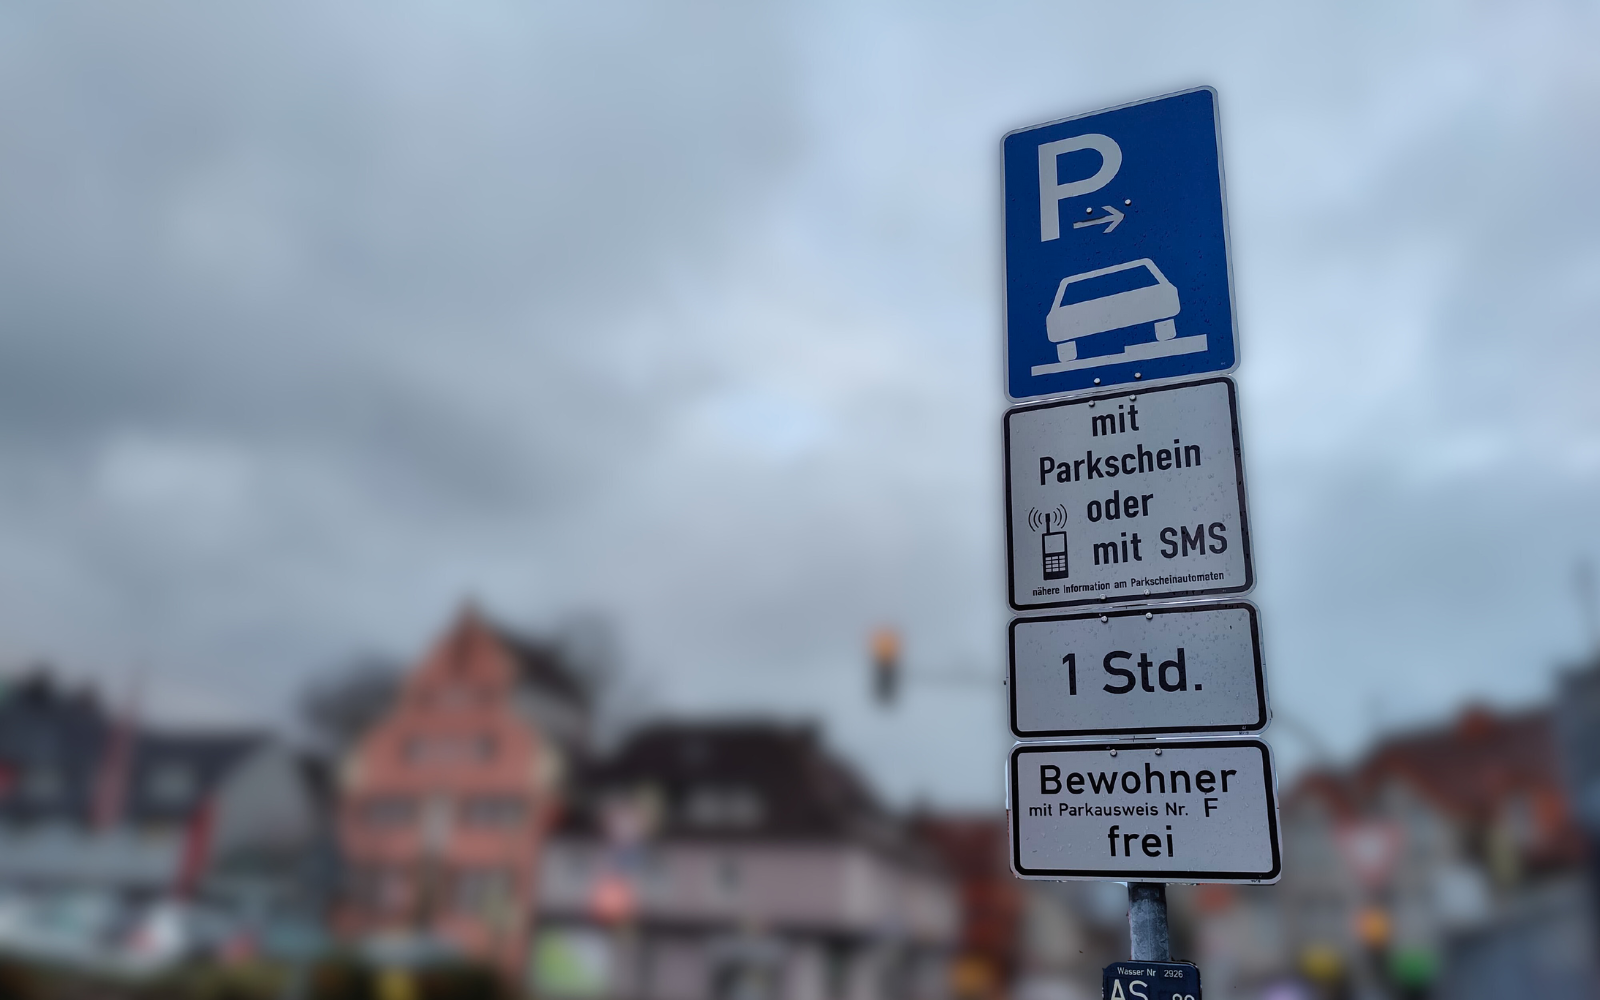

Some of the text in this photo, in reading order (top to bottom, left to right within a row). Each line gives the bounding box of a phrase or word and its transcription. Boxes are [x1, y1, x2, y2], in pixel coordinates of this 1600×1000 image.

[1038, 133, 1123, 242] P
[1091, 404, 1139, 436] mit
[1039, 438, 1202, 485] Parkschein
[1087, 489, 1154, 523] oder
[1093, 522, 1228, 565] mit SMS
[1032, 571, 1225, 597] nähere Information am Parkscheinautomaten
[1062, 647, 1203, 695] 1 Std.
[1039, 762, 1237, 795] Bewohner
[1029, 797, 1219, 818] mit Parkausweis Nr. F
[1107, 824, 1174, 858] frei
[1117, 966, 1184, 979] Wasser Nr 2926
